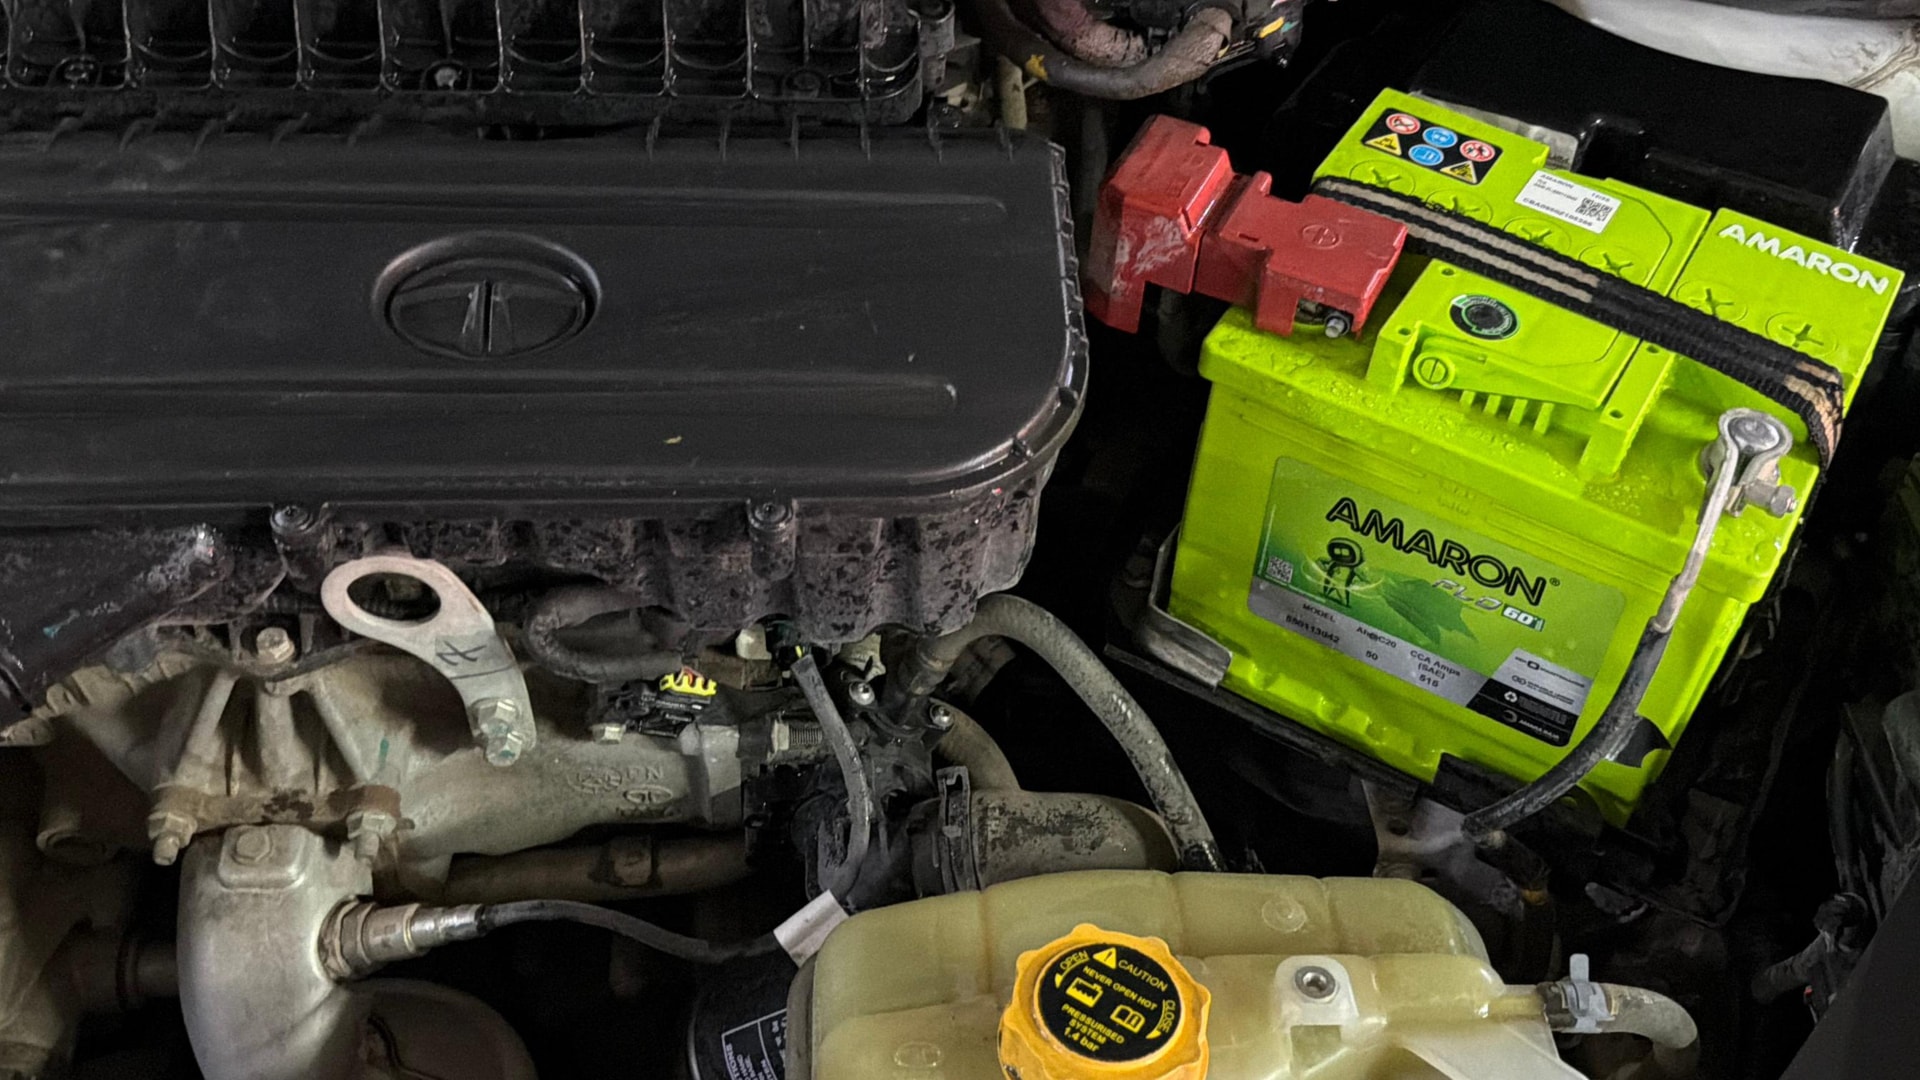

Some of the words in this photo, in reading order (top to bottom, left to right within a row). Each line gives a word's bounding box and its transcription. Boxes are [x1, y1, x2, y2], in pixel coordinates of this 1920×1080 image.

[1719, 223, 1889, 295] AMARON
[1303, 603, 1336, 623] MODEL
[1365, 651, 1379, 661] 50
[1410, 650, 1431, 665] CCA
[1434, 660, 1461, 677] Amps
[1060, 950, 1089, 970] OPEN
[1083, 966, 1112, 986] NEVER
[1113, 982, 1136, 999] OPEN
[1137, 995, 1158, 1011] HOT
[1118, 960, 1168, 992] CAUTION
[1061, 1003, 1125, 1044] PRESSURISED
[1163, 1000, 1176, 1034] CLOSE
[1064, 1027, 1079, 1041] 1.4
[1080, 1036, 1099, 1052] bar
[1068, 1019, 1107, 1045] SYSTEM
